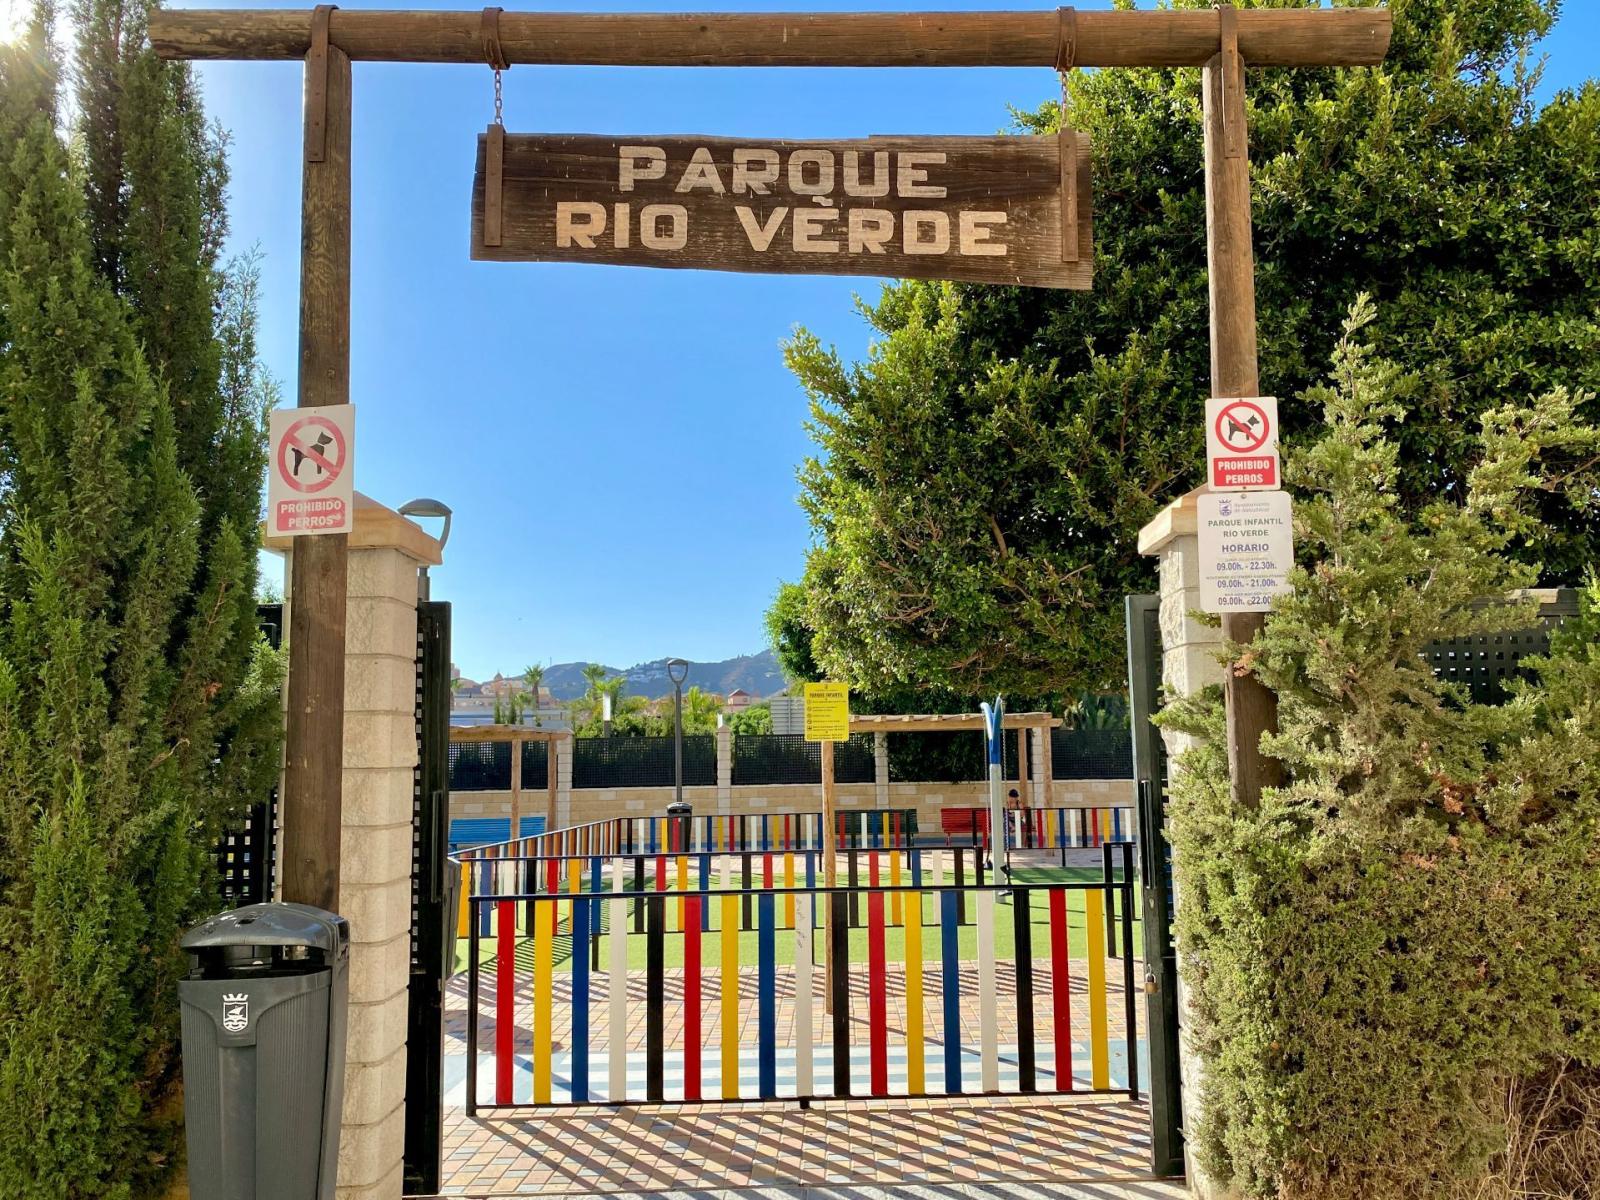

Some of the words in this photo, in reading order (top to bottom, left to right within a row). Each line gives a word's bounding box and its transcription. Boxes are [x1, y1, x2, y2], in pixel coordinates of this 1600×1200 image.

[618, 145, 948, 204] PARQUE
[555, 201, 688, 250] RIO
[734, 205, 1008, 256] VERDE
[1218, 460, 1270, 471] PROHIBIDO
[1225, 474, 1263, 484] PERROS
[280, 500, 342, 514] PROHIBIDO
[288, 515, 334, 527] PERROS
[1208, 519, 1242, 527] PARQUE
[1244, 518, 1283, 526] INFANTIL
[1240, 529, 1269, 537] VERDE
[1222, 543, 1269, 552] HORARIO
[1251, 596, 1272, 605] 22.00
